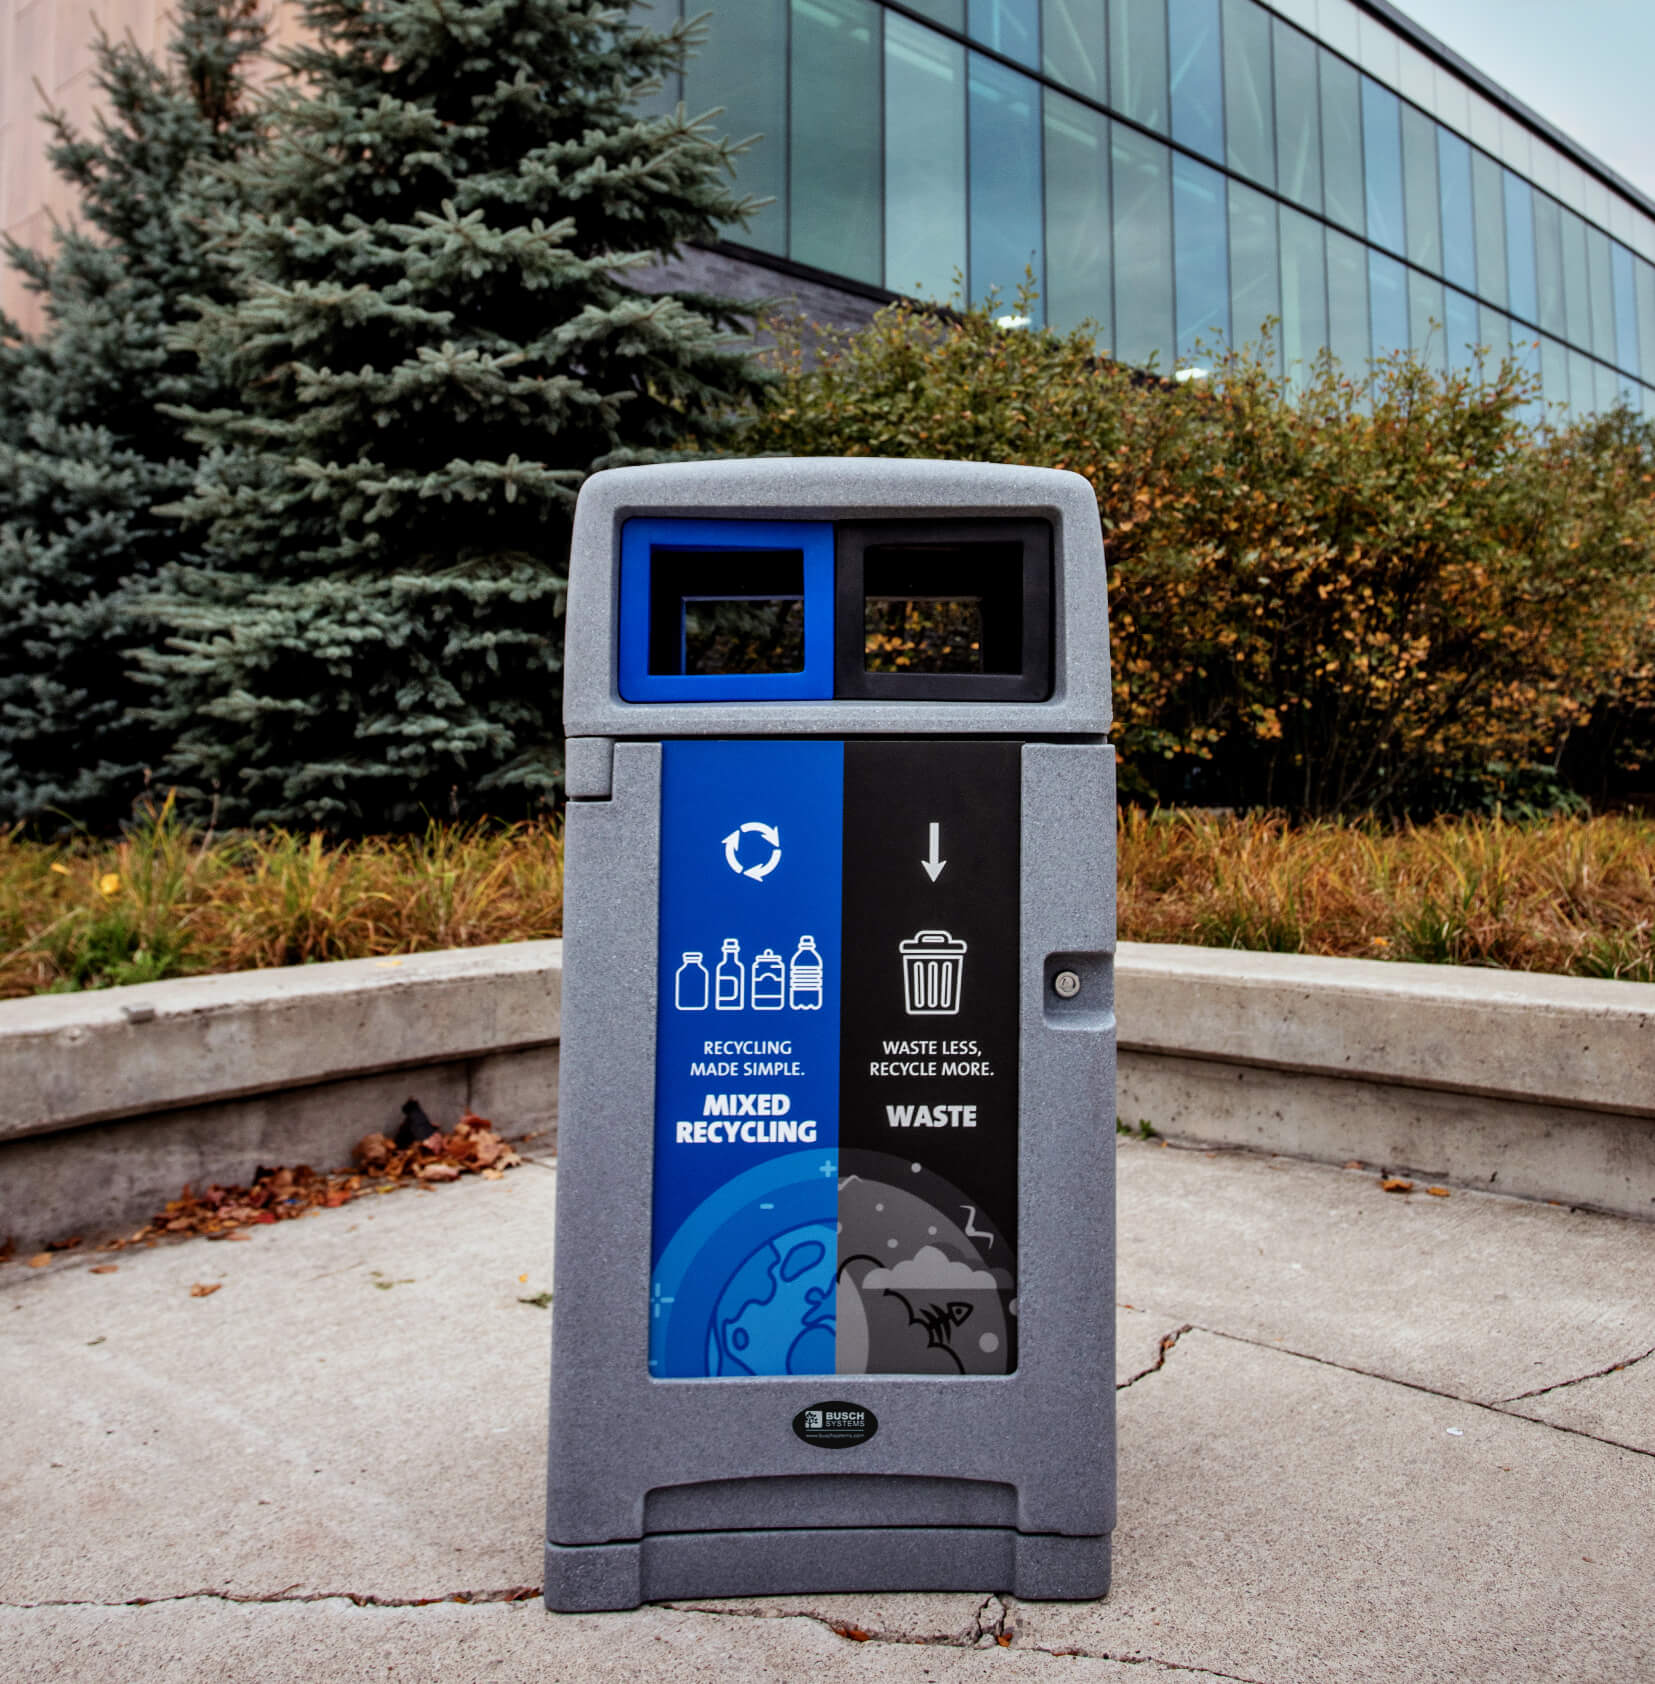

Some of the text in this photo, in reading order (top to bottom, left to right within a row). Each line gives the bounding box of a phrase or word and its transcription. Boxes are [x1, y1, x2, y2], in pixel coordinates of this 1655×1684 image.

[703, 1040, 793, 1056] RECYCLING
[882, 1040, 983, 1058] WASTE LESS,
[689, 1061, 806, 1077] MADE SIMPLE.
[869, 1061, 995, 1077] RECYCLE MORE.
[702, 1093, 791, 1117] MIXED
[885, 1104, 978, 1128] WASTE
[675, 1119, 818, 1144] RECYCLING
[825, 1411, 865, 1420] BUSCH
